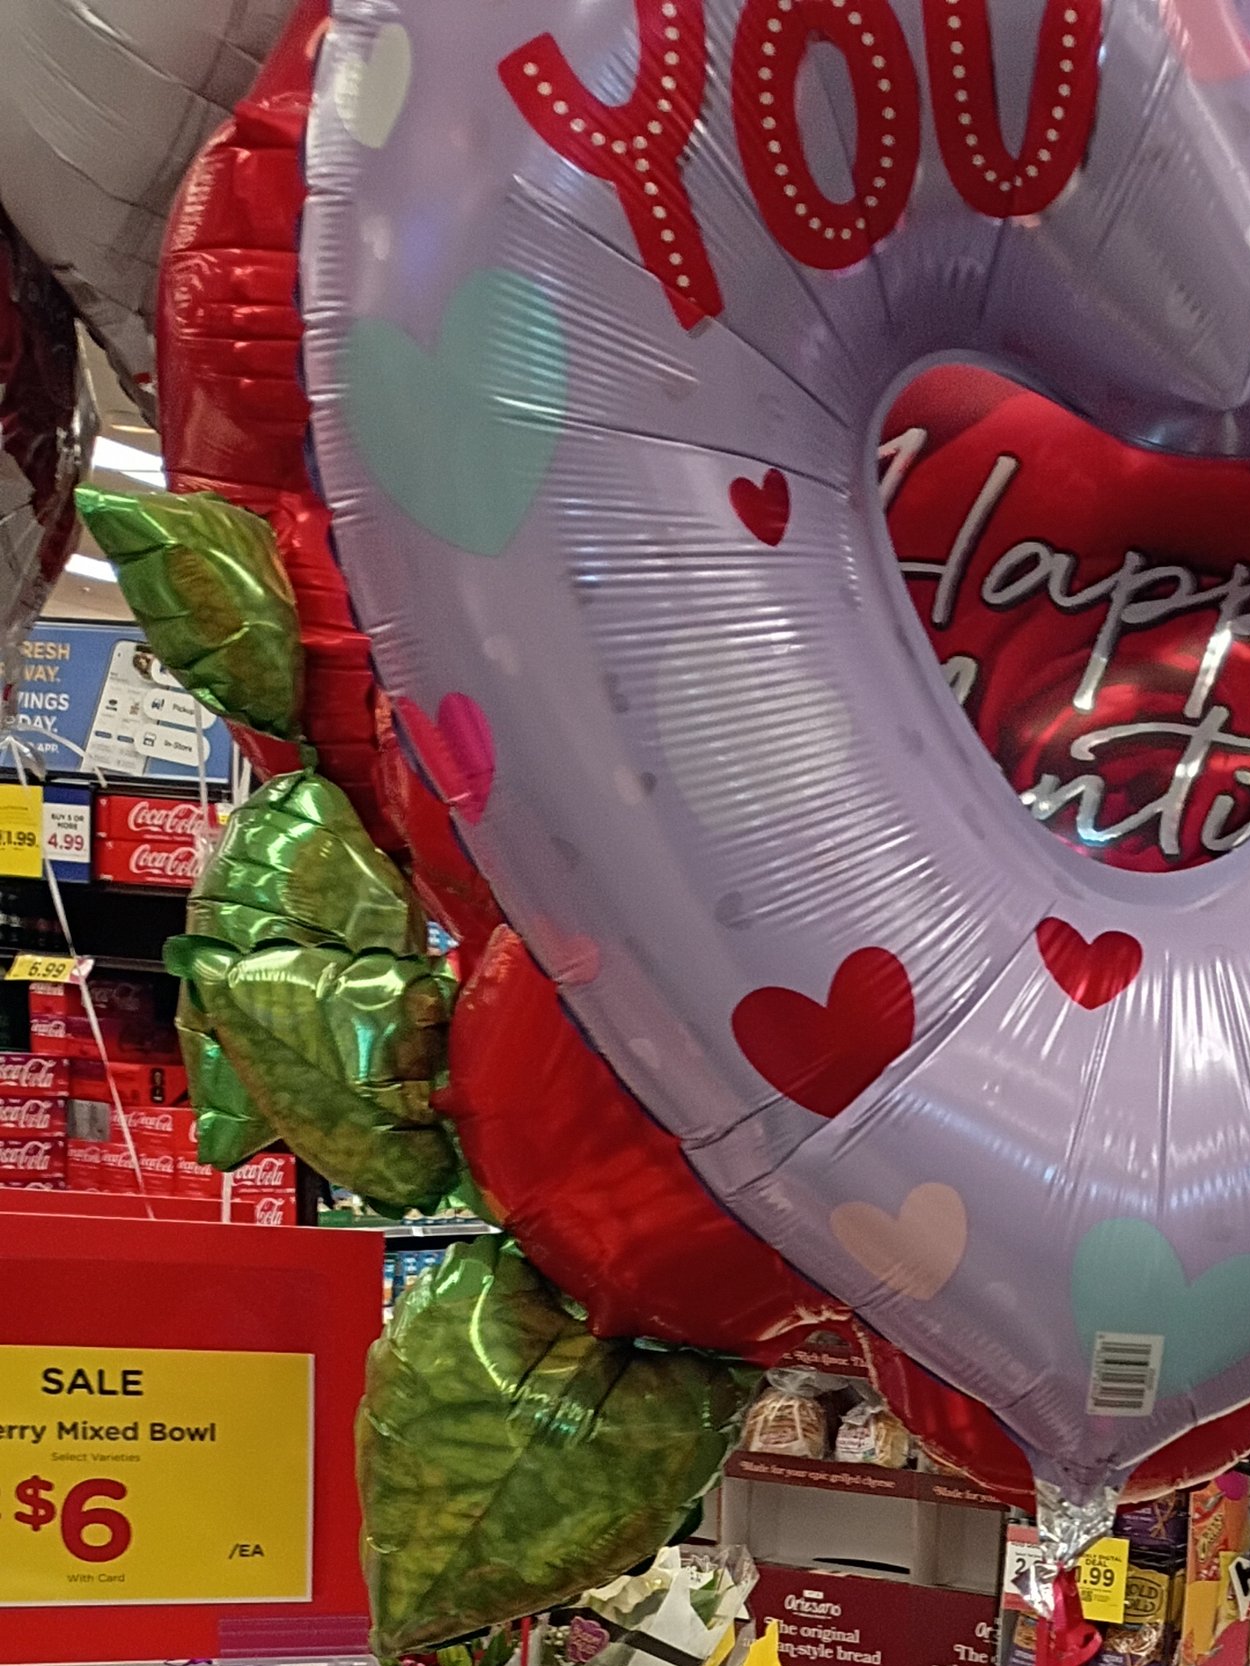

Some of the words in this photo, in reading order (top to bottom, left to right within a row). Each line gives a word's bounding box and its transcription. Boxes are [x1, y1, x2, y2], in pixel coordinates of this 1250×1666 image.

[498, 0, 1102, 331] YOU
[21, 640, 71, 660] RESH
[17, 692, 70, 711] VINGS
[48, 835, 84, 850] 4.99
[27, 961, 66, 978] 6.99
[41, 1368, 145, 1396] SALE
[0, 1423, 47, 1444] erry
[57, 1421, 140, 1441] Mixed
[149, 1422, 217, 1442] Bowl
[51, 1452, 88, 1462] Select
[92, 1452, 141, 1462] Varieties
[14, 1474, 132, 1563] $6
[229, 1543, 265, 1559] /EA
[1085, 1558, 1108, 1568] DEAL
[67, 1573, 94, 1583] With
[98, 1573, 125, 1583] Card
[1075, 1566, 1115, 1588] 1.99
[799, 1626, 860, 1643] original
[777, 1642, 835, 1660] an-style
[836, 1647, 881, 1665] bread
[953, 1644, 989, 1663] The
